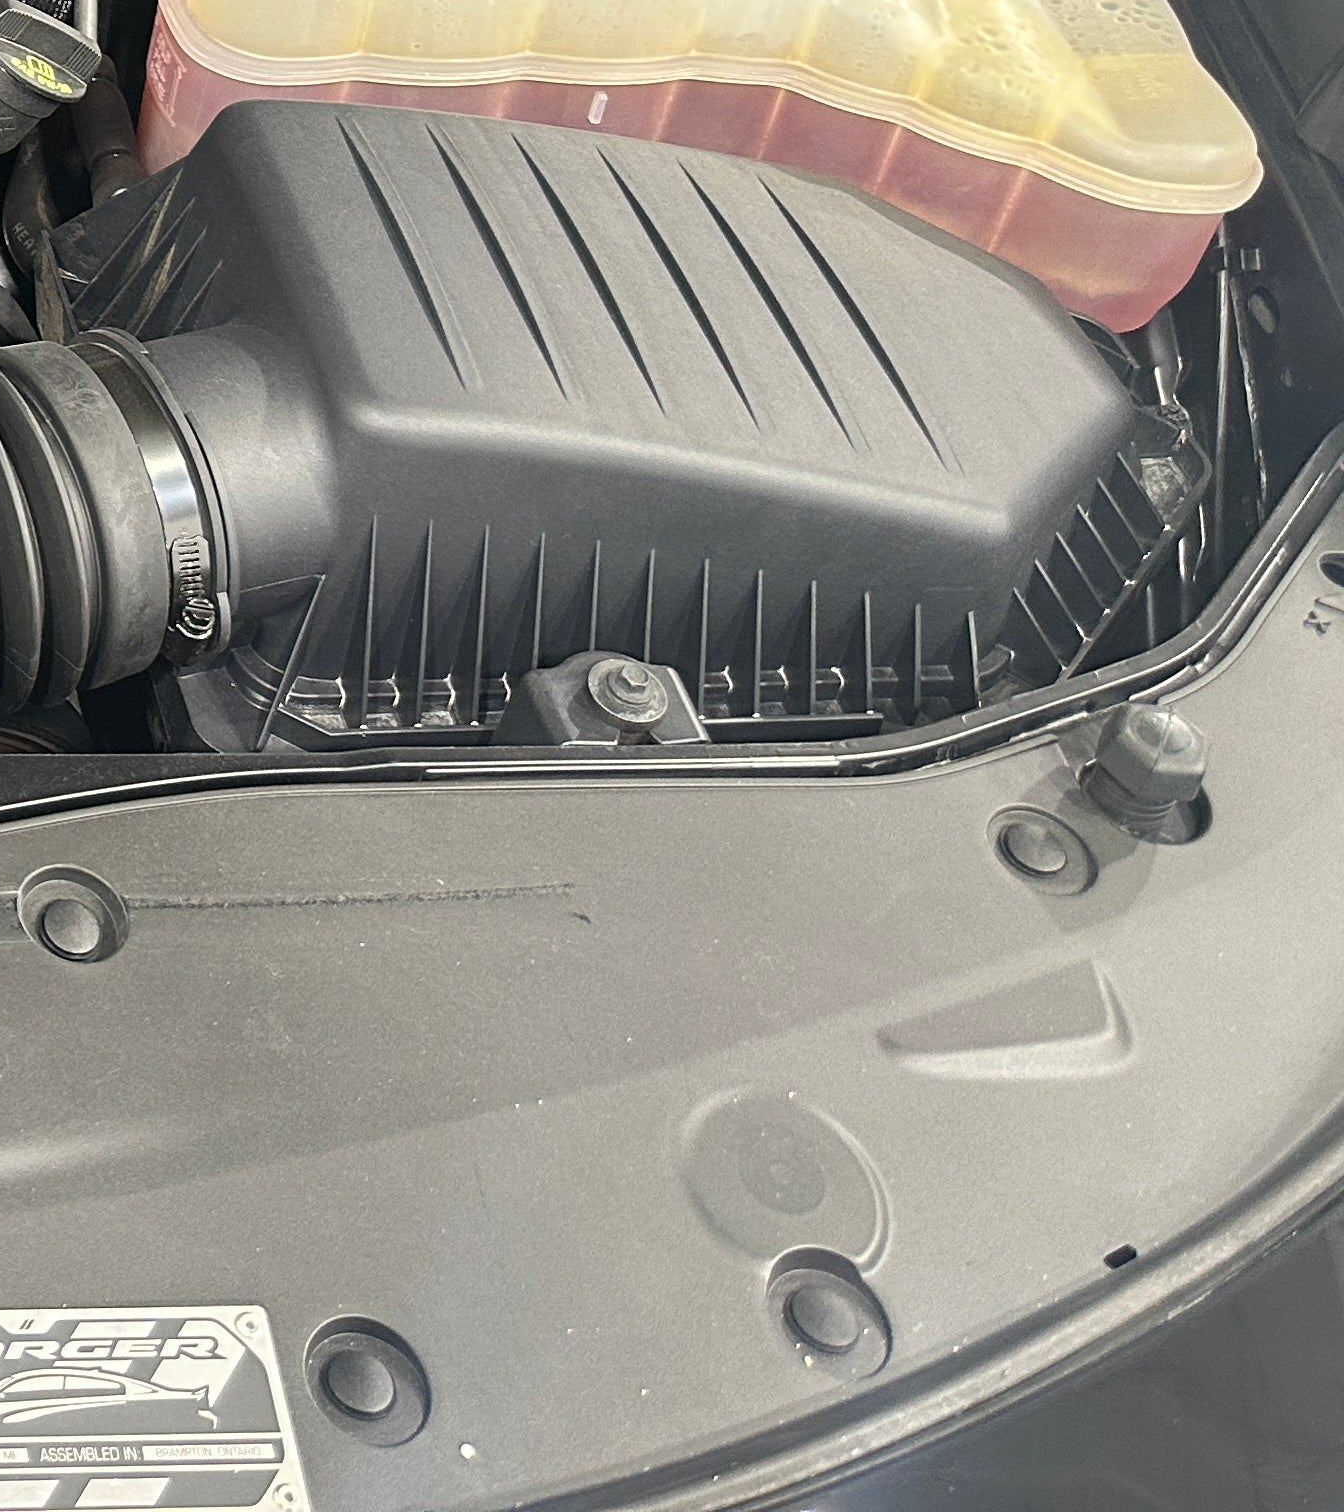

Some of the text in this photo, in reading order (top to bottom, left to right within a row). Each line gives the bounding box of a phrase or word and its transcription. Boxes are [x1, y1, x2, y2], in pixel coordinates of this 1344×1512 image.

[40, 1445, 120, 1462] ASSEMBLED
[122, 1445, 142, 1461] IN:
[155, 1446, 212, 1458] BRAMPTON
[217, 1445, 262, 1457] ONTARIO
